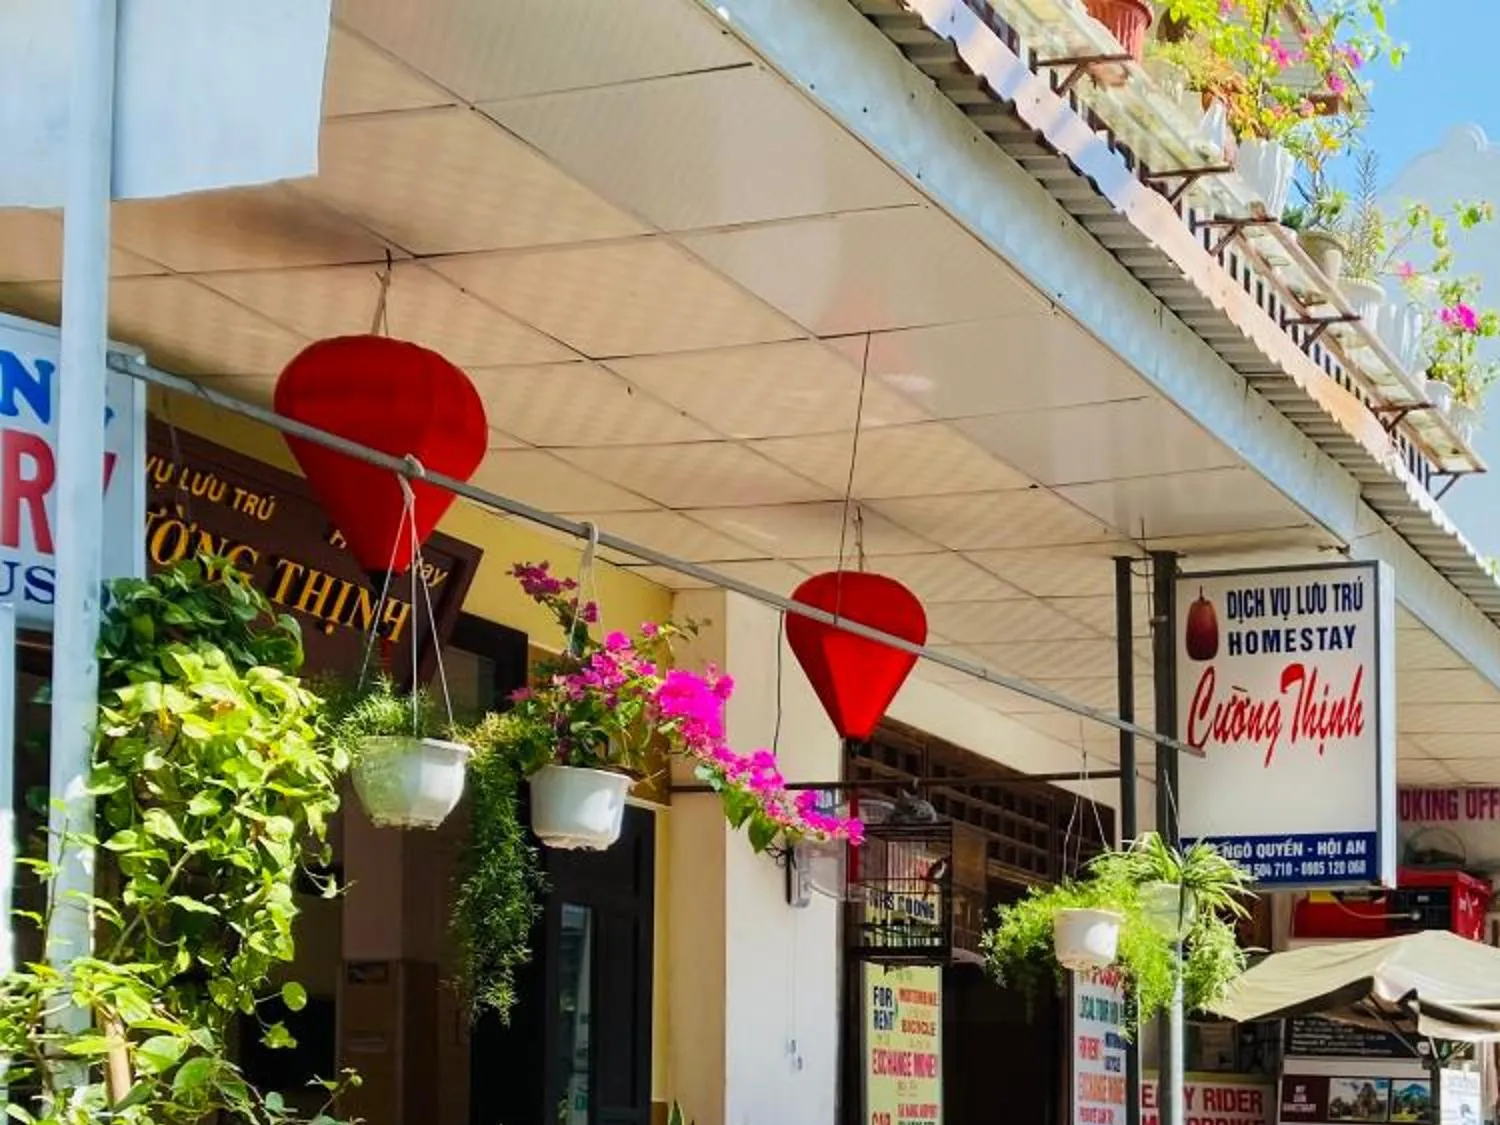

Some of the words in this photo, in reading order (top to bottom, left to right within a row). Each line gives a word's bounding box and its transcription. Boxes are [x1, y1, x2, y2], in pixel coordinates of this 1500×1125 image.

[180, 466, 227, 503] LƯU
[233, 486, 276, 521] TRÚ
[1227, 588, 1265, 624] DỊCH
[1270, 586, 1291, 621] VỤ
[1332, 576, 1364, 612] TRÚ
[1228, 624, 1357, 656] HOMESTAY
[1187, 666, 1282, 768] Cường
[1280, 663, 1365, 756] Thịnh
[1317, 838, 1343, 859] HỘI
[1346, 839, 1367, 855] AN
[873, 986, 893, 1007] FOR
[873, 1010, 894, 1031] RENT
[1203, 1087, 1263, 1113] RIDER
